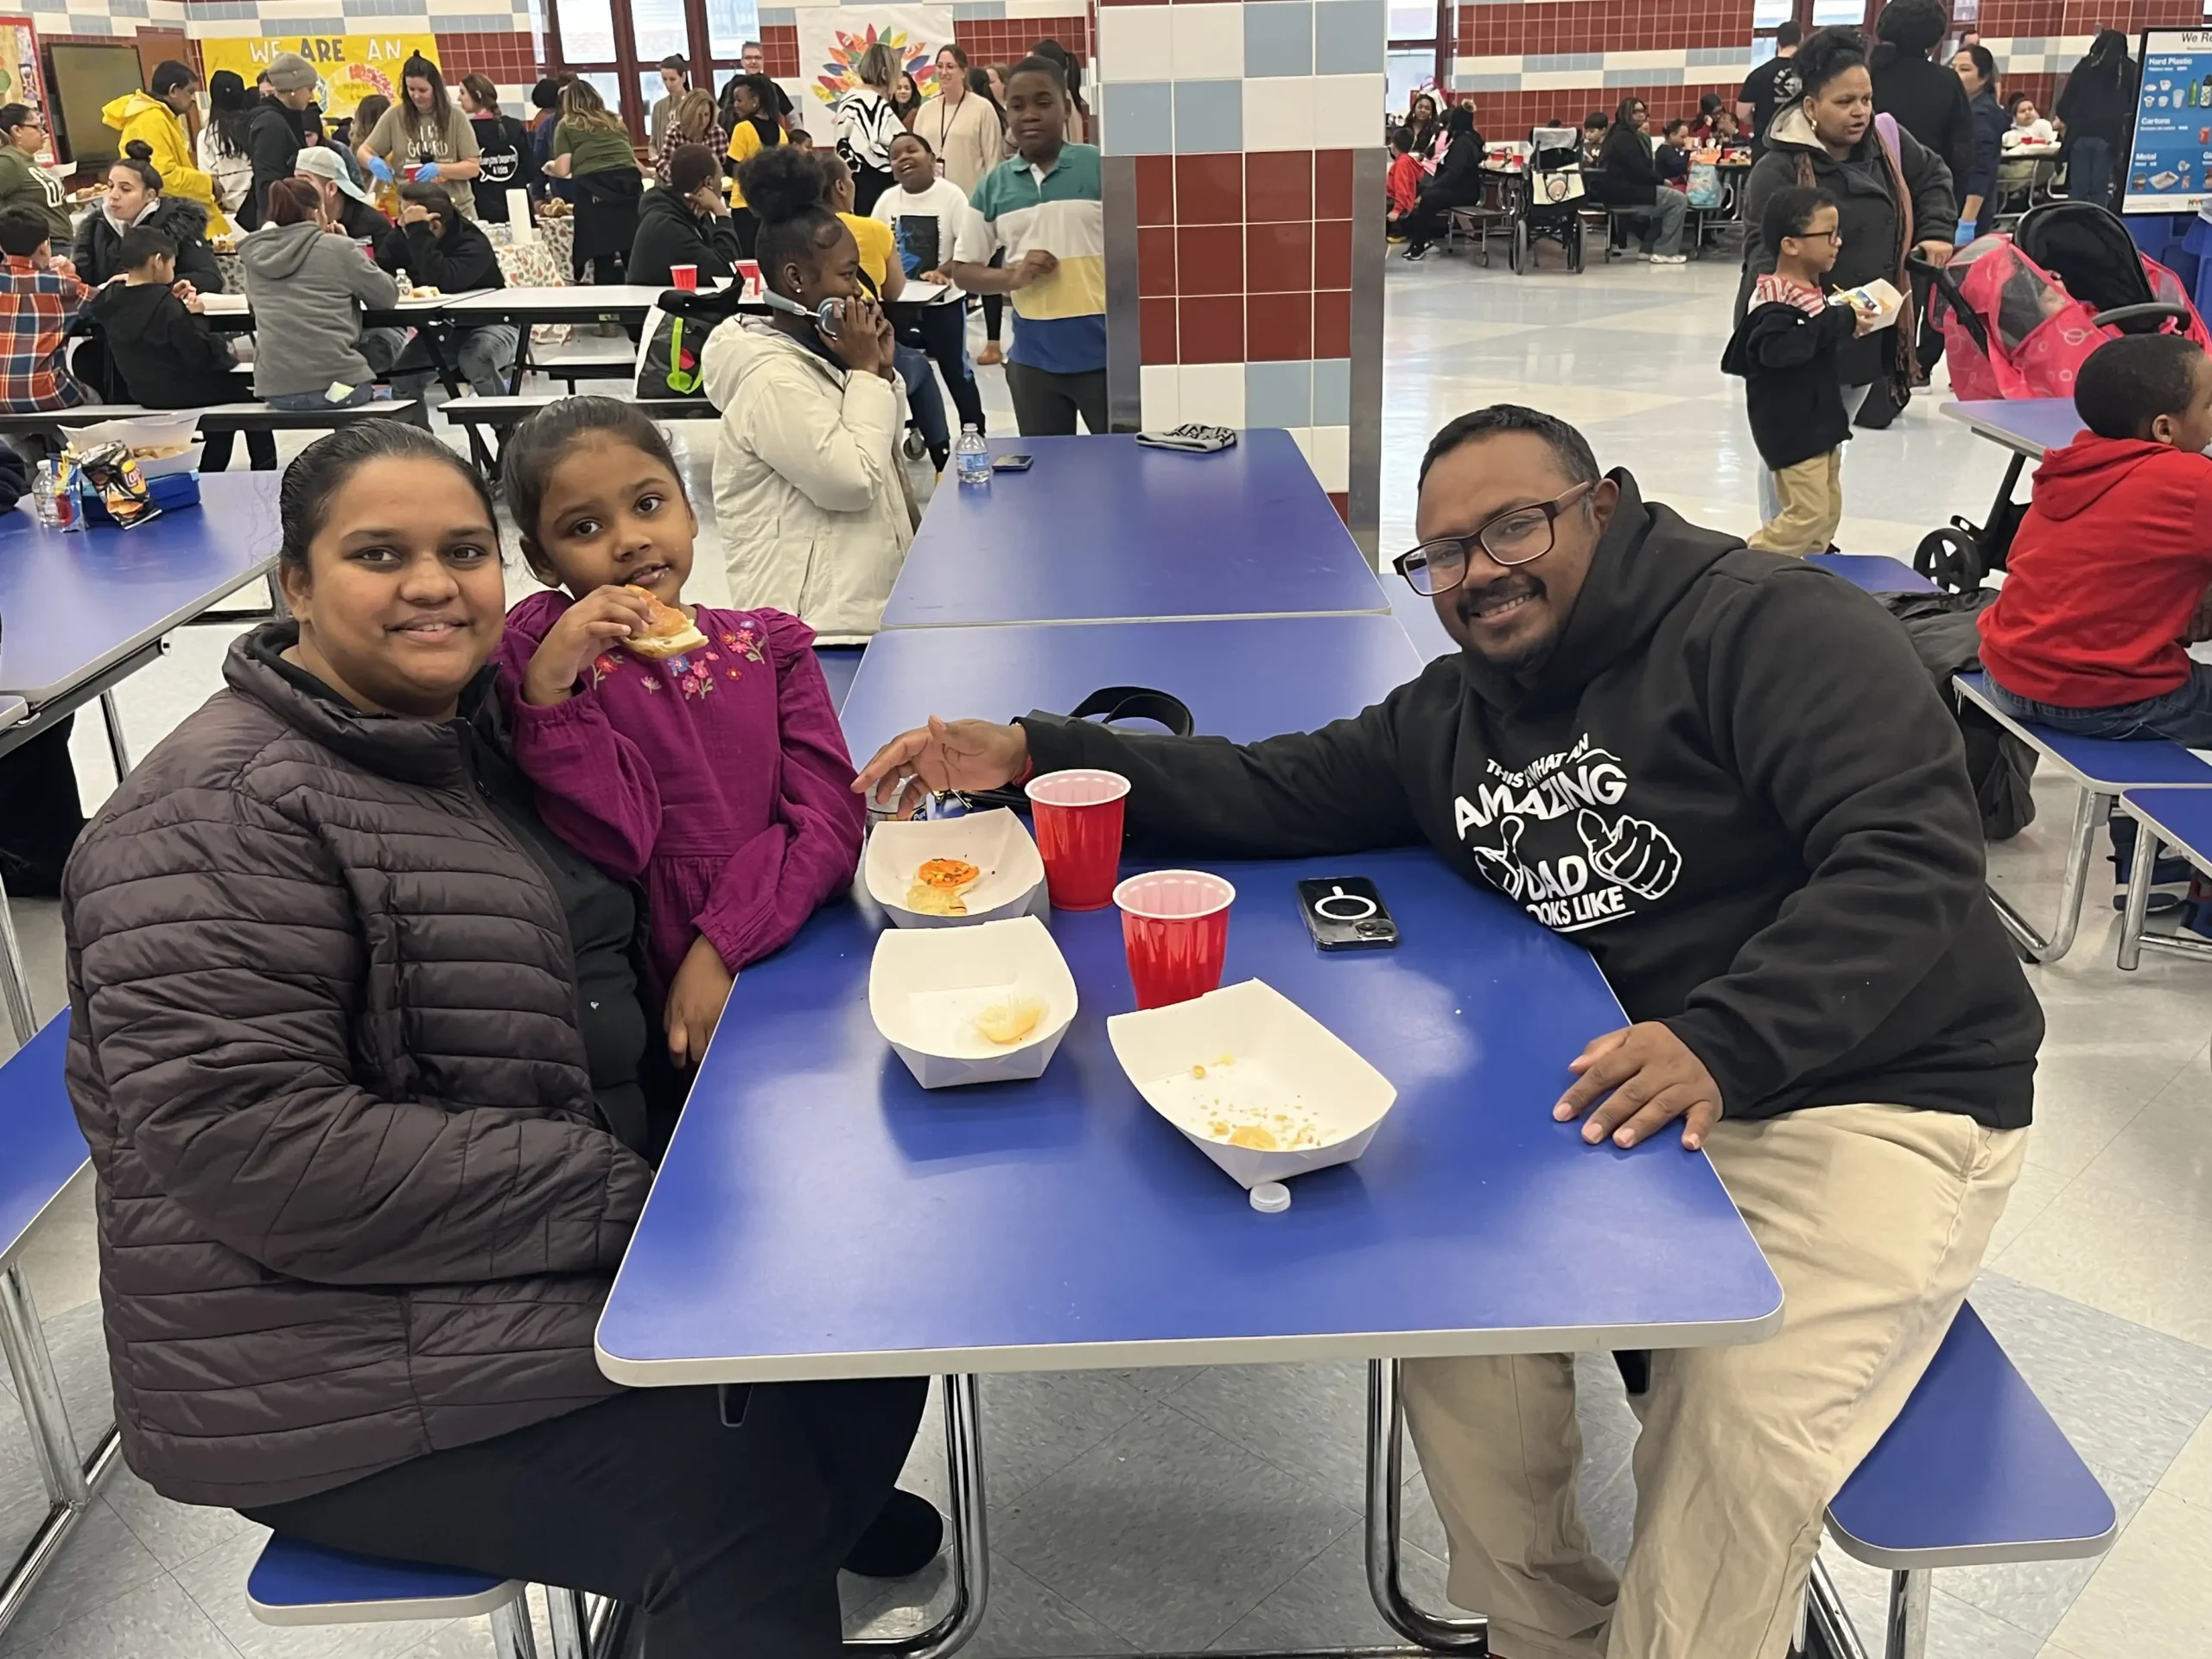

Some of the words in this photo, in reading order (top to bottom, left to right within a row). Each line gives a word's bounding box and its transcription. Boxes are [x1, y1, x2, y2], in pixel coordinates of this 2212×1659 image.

[301, 38, 346, 62] ARE
[366, 38, 401, 61] AN
[1486, 759, 1524, 788] THIS
[1565, 733, 1589, 764] AN
[1454, 763, 1628, 841] AMAZING
[1522, 855, 1588, 901] DAD
[1572, 885, 1626, 921] LIKE
